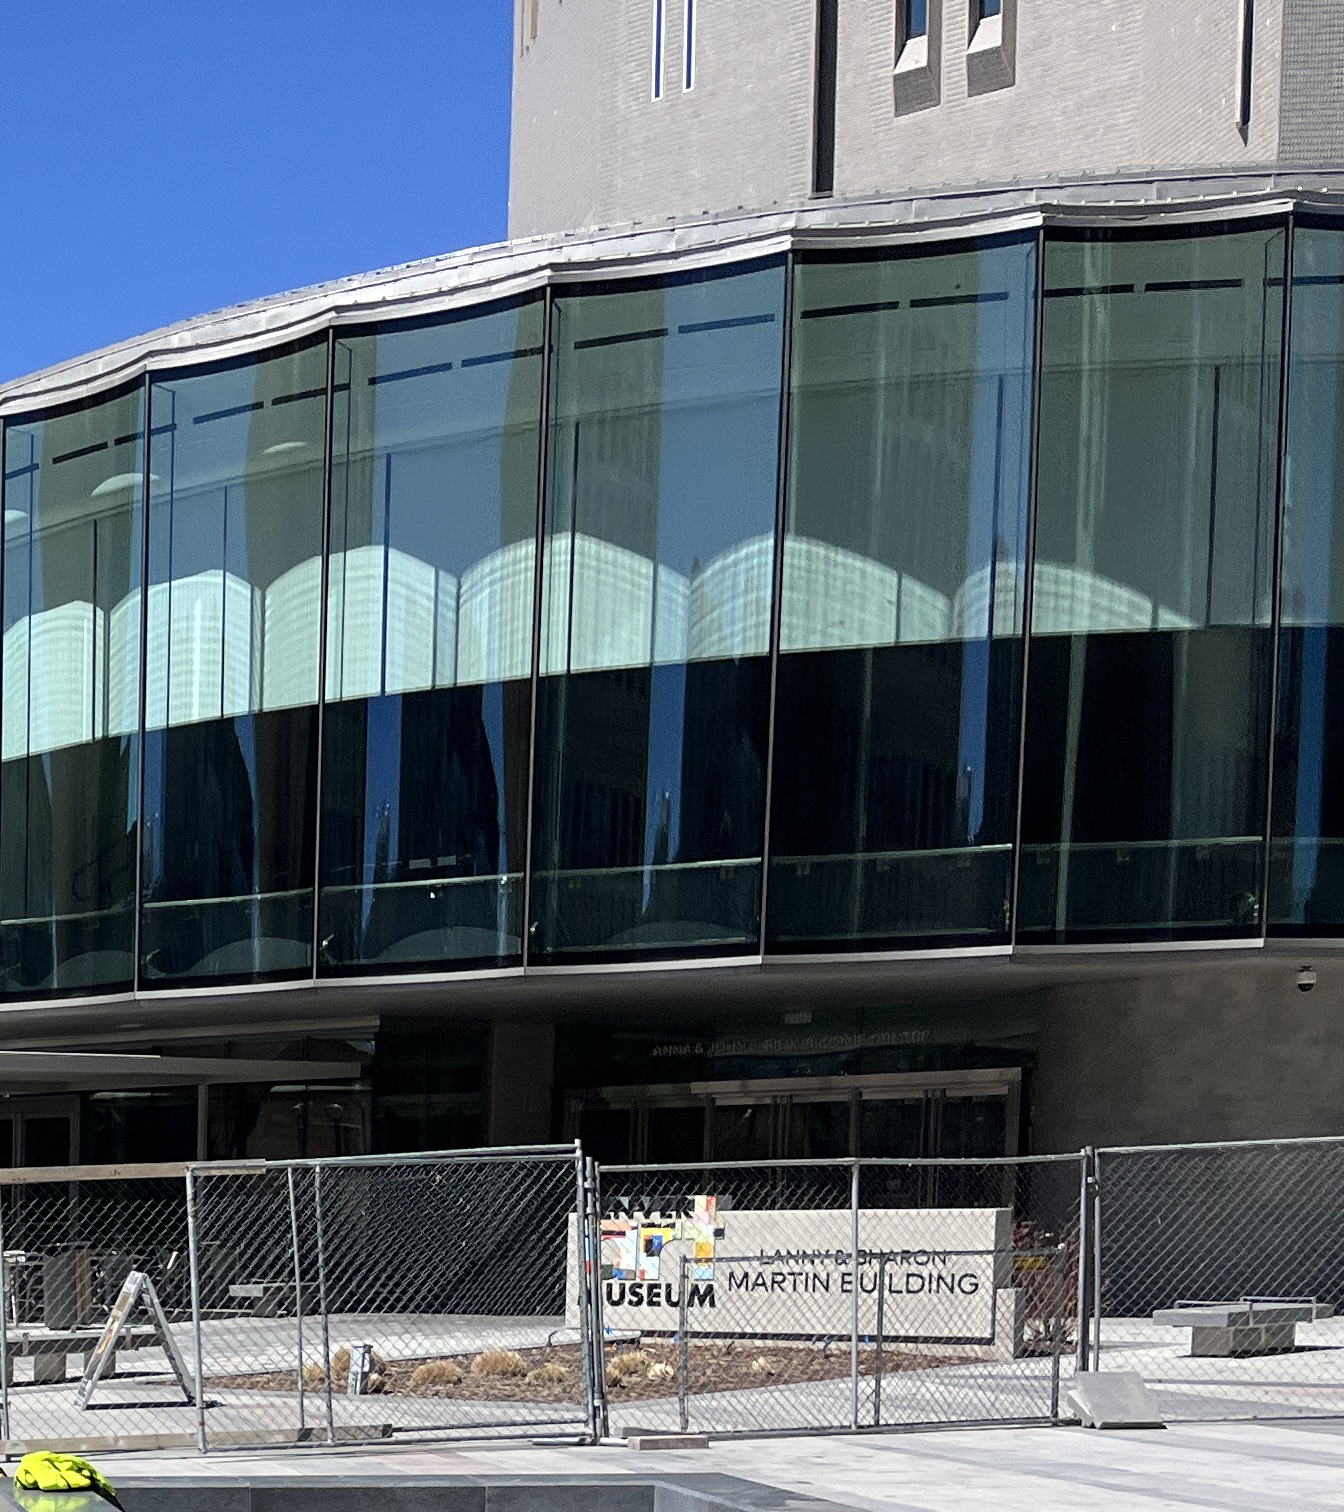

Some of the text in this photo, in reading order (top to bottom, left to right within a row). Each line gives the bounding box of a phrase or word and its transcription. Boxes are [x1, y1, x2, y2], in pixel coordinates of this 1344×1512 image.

[592, 1282, 716, 1308] USEUM
[728, 1271, 979, 1296] MARTIN BULDING
